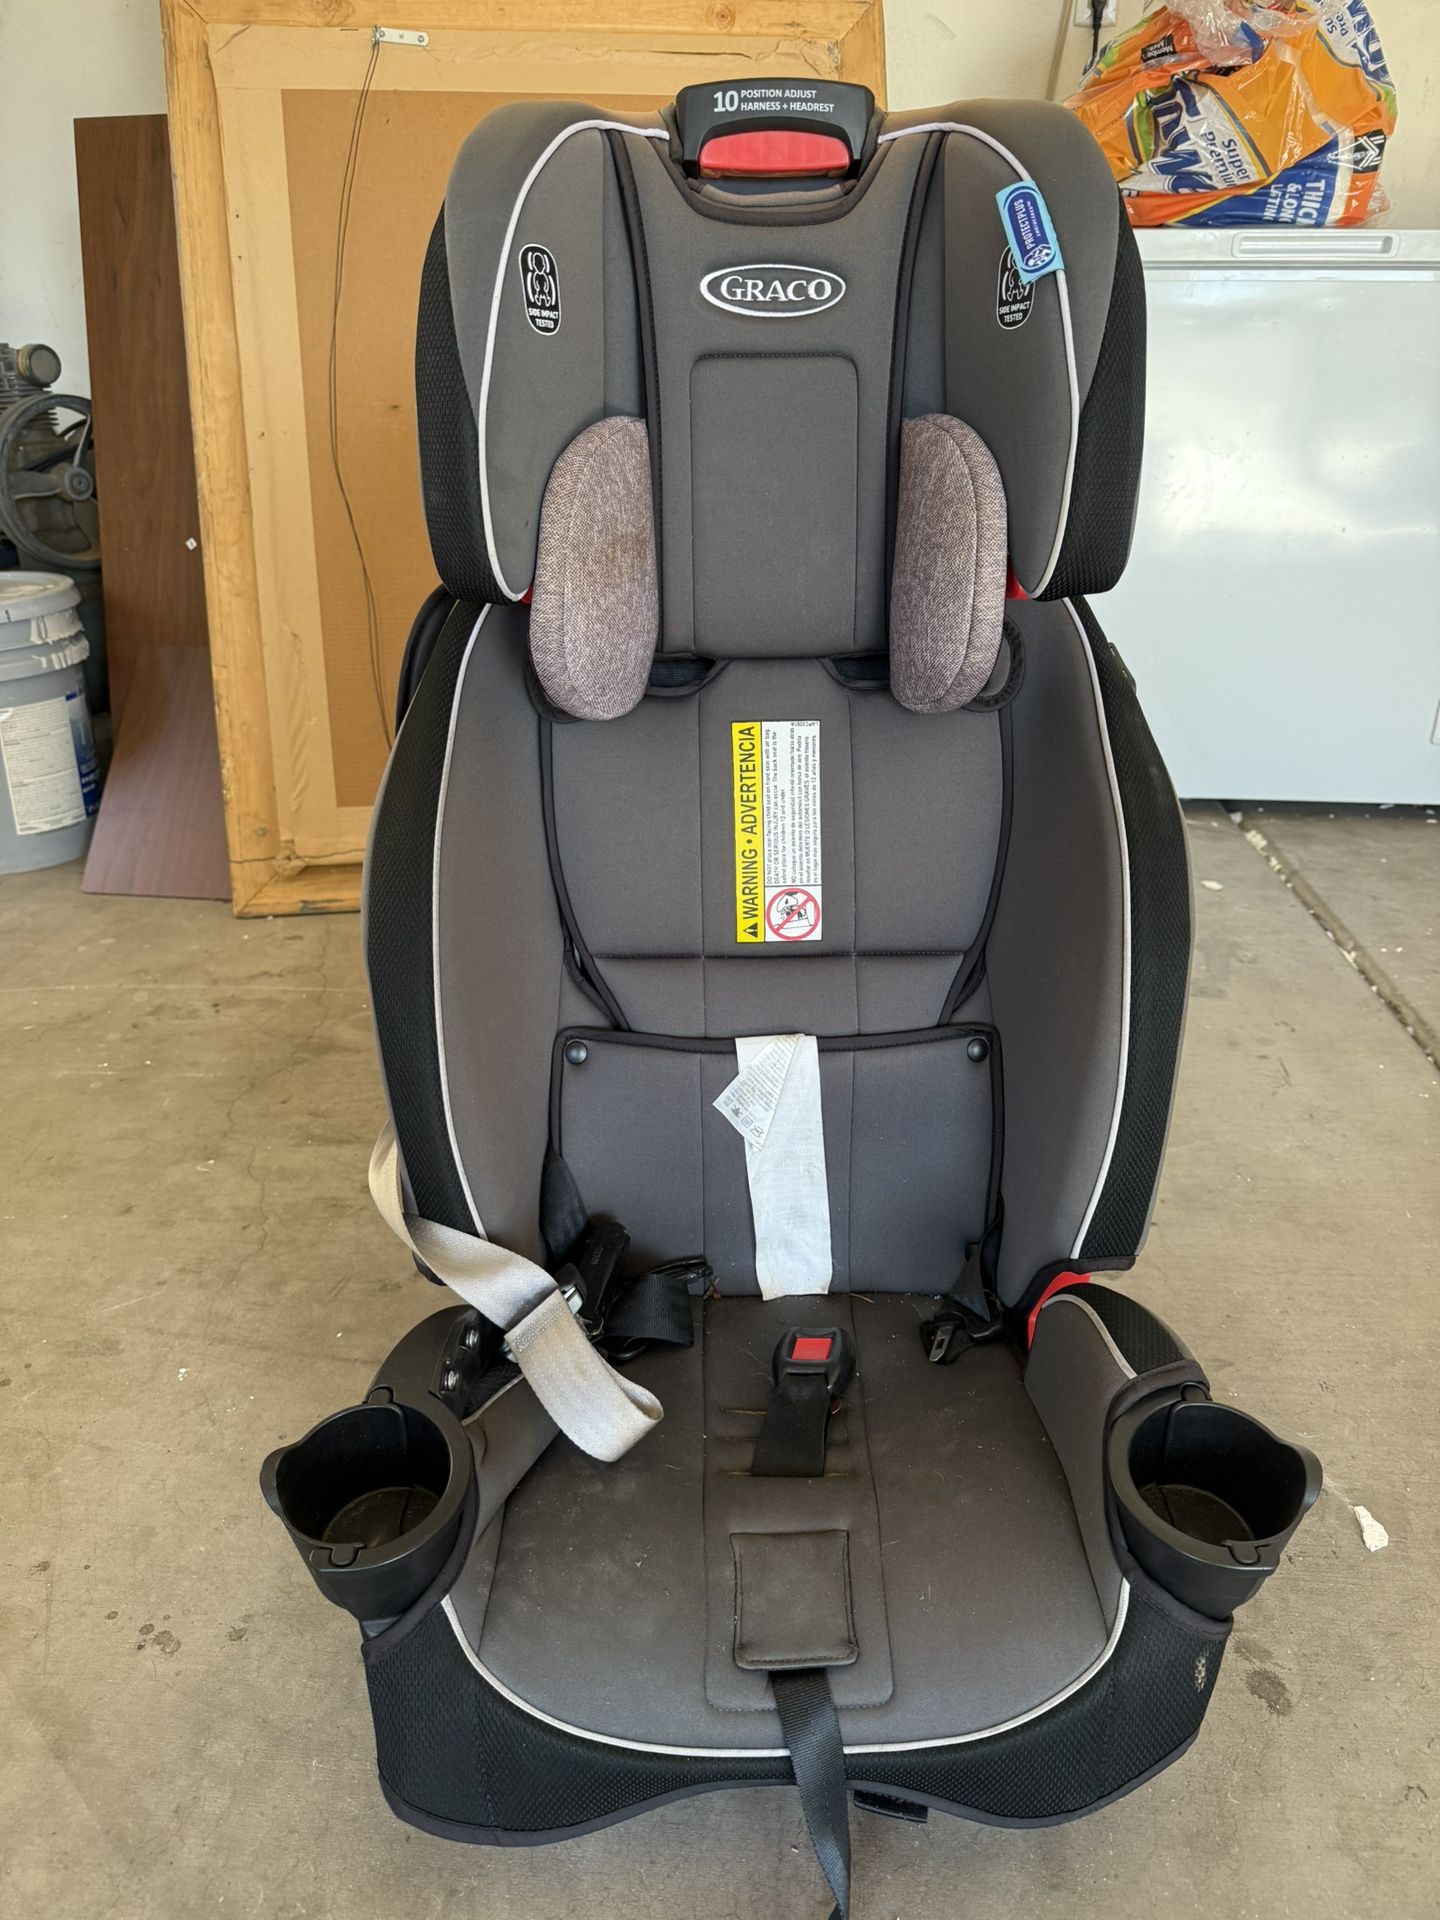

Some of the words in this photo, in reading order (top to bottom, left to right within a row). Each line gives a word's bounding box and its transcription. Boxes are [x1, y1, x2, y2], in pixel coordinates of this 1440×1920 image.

[713, 90, 739, 112] 10
[741, 89, 782, 98] POSITION
[784, 89, 817, 99] ADJUST
[741, 102, 781, 111] HARNESS
[789, 102, 835, 112] HEADREST
[1222, 138, 1251, 181] Super
[1014, 199, 1036, 251] PROTECTPLUS
[720, 275, 832, 301] GRACO
[529, 308, 540, 317] SIDE
[541, 310, 558, 319] IMPACT
[999, 304, 1011, 315] SIDE
[1011, 301, 1030, 312] IMPACT
[535, 319, 554, 328] TESTED
[1004, 313, 1023, 323] TESTED
[738, 726, 758, 835] ADVERTENCIA
[741, 849, 758, 919] WARNING
